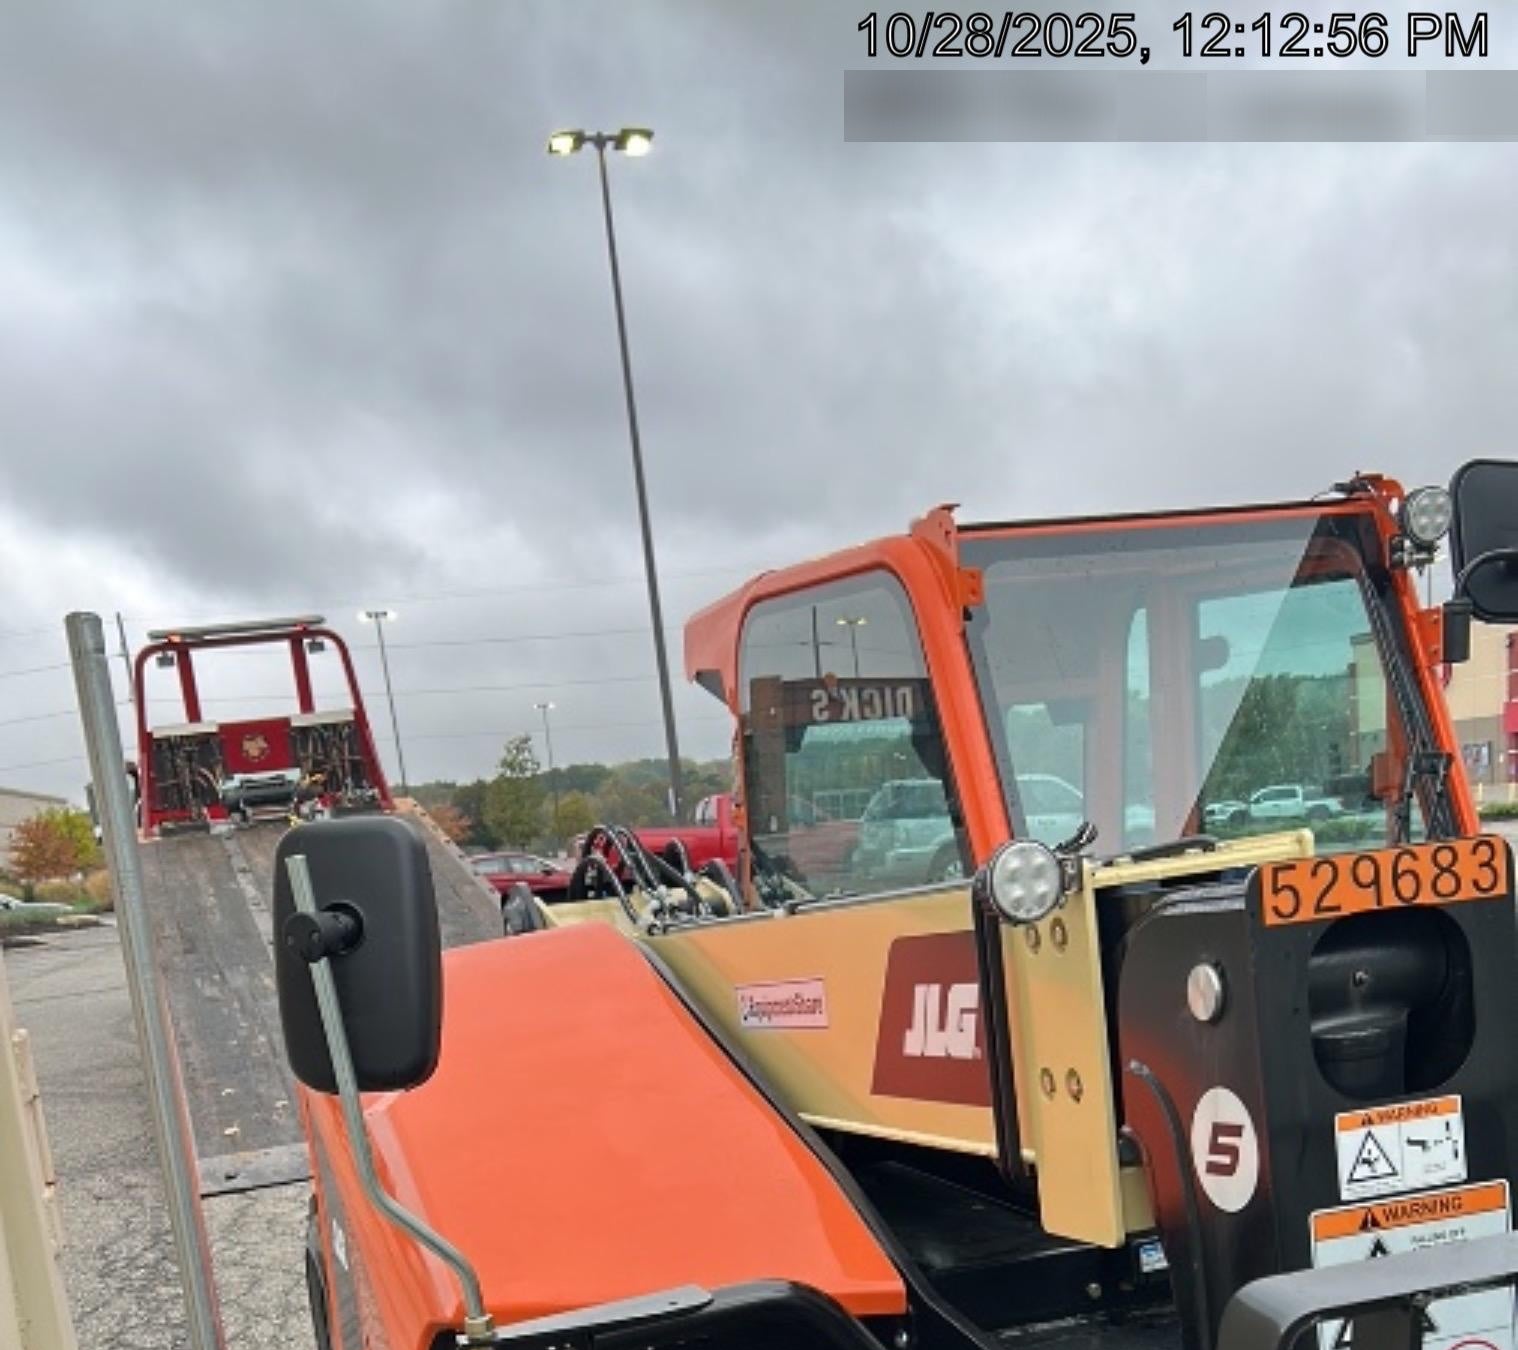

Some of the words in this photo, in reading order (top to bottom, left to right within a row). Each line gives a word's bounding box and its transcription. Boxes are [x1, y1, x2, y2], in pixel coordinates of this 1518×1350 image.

[1271, 838, 1499, 920] 529683
[903, 983, 979, 1059] JLG
[1206, 1122, 1244, 1176] 5
[1382, 1196, 1463, 1223] WARNING
